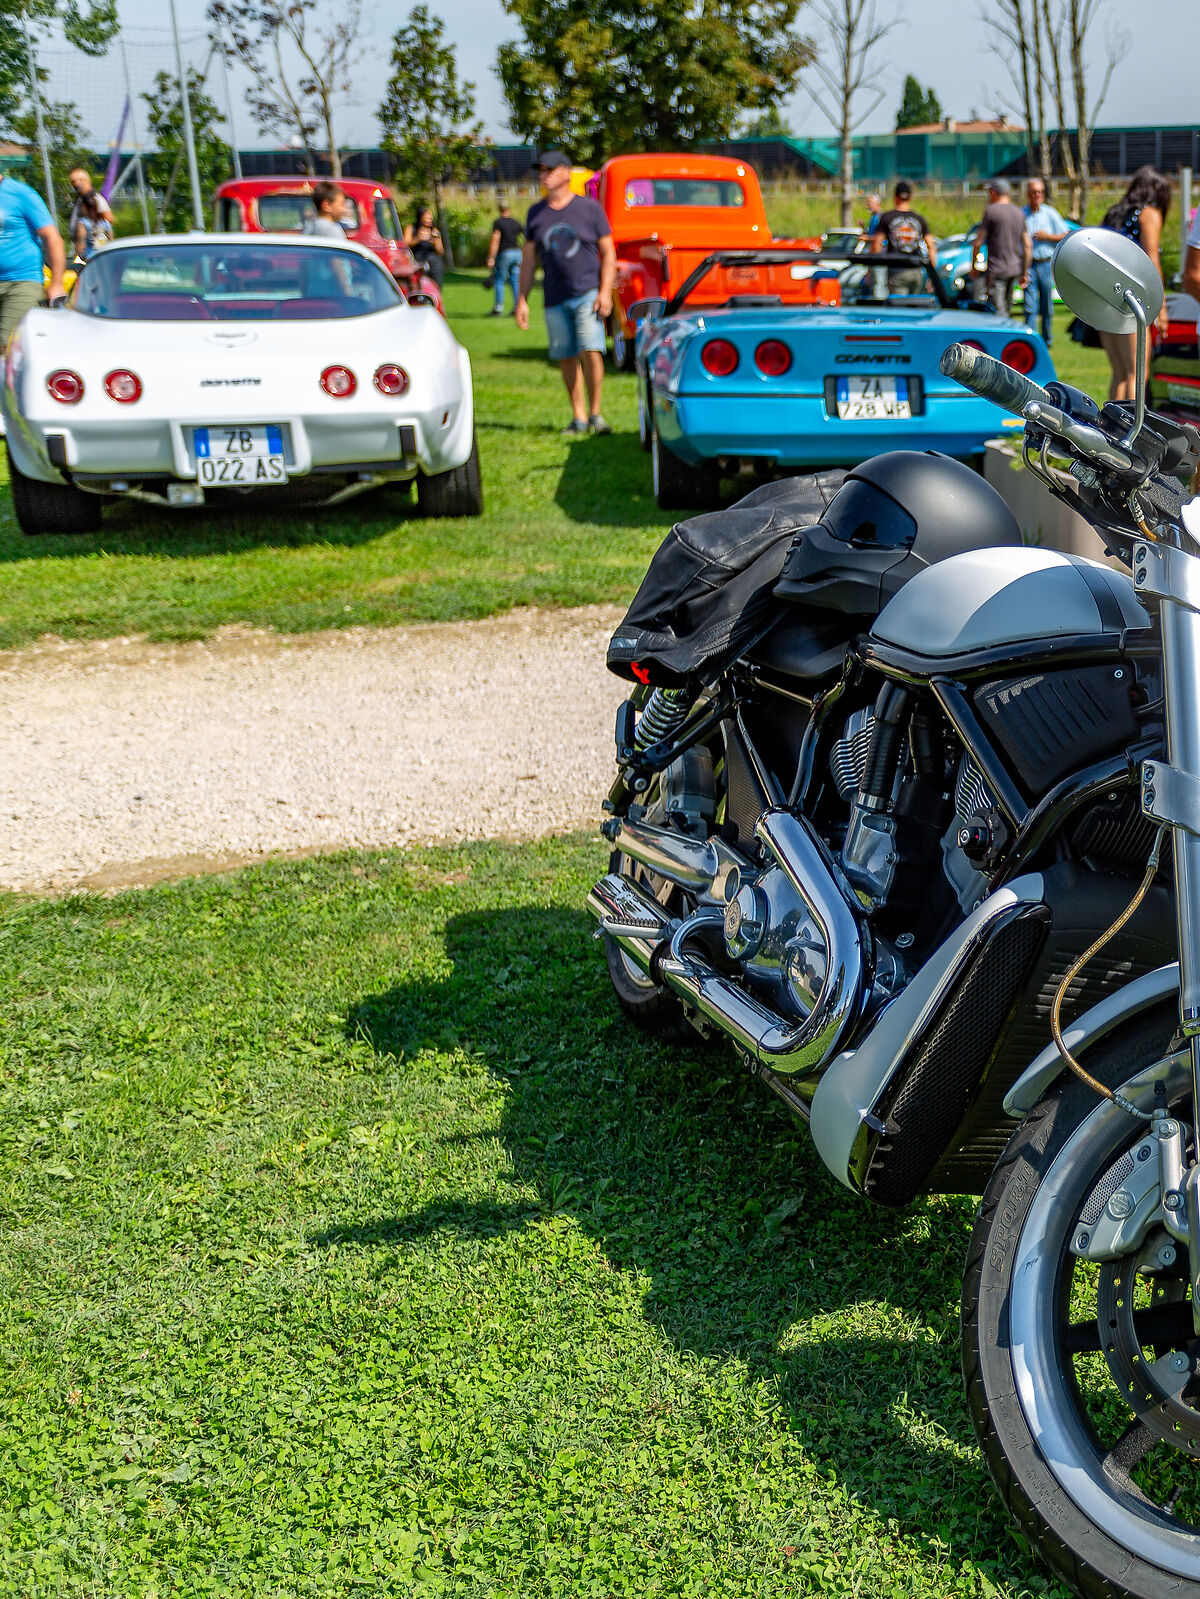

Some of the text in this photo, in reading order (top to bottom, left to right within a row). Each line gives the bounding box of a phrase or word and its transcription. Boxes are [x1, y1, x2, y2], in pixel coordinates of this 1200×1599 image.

[861, 378, 883, 399] ZA
[840, 401, 906, 416] 728 WP
[223, 429, 253, 453] ZB
[202, 457, 282, 482] 022 AS
